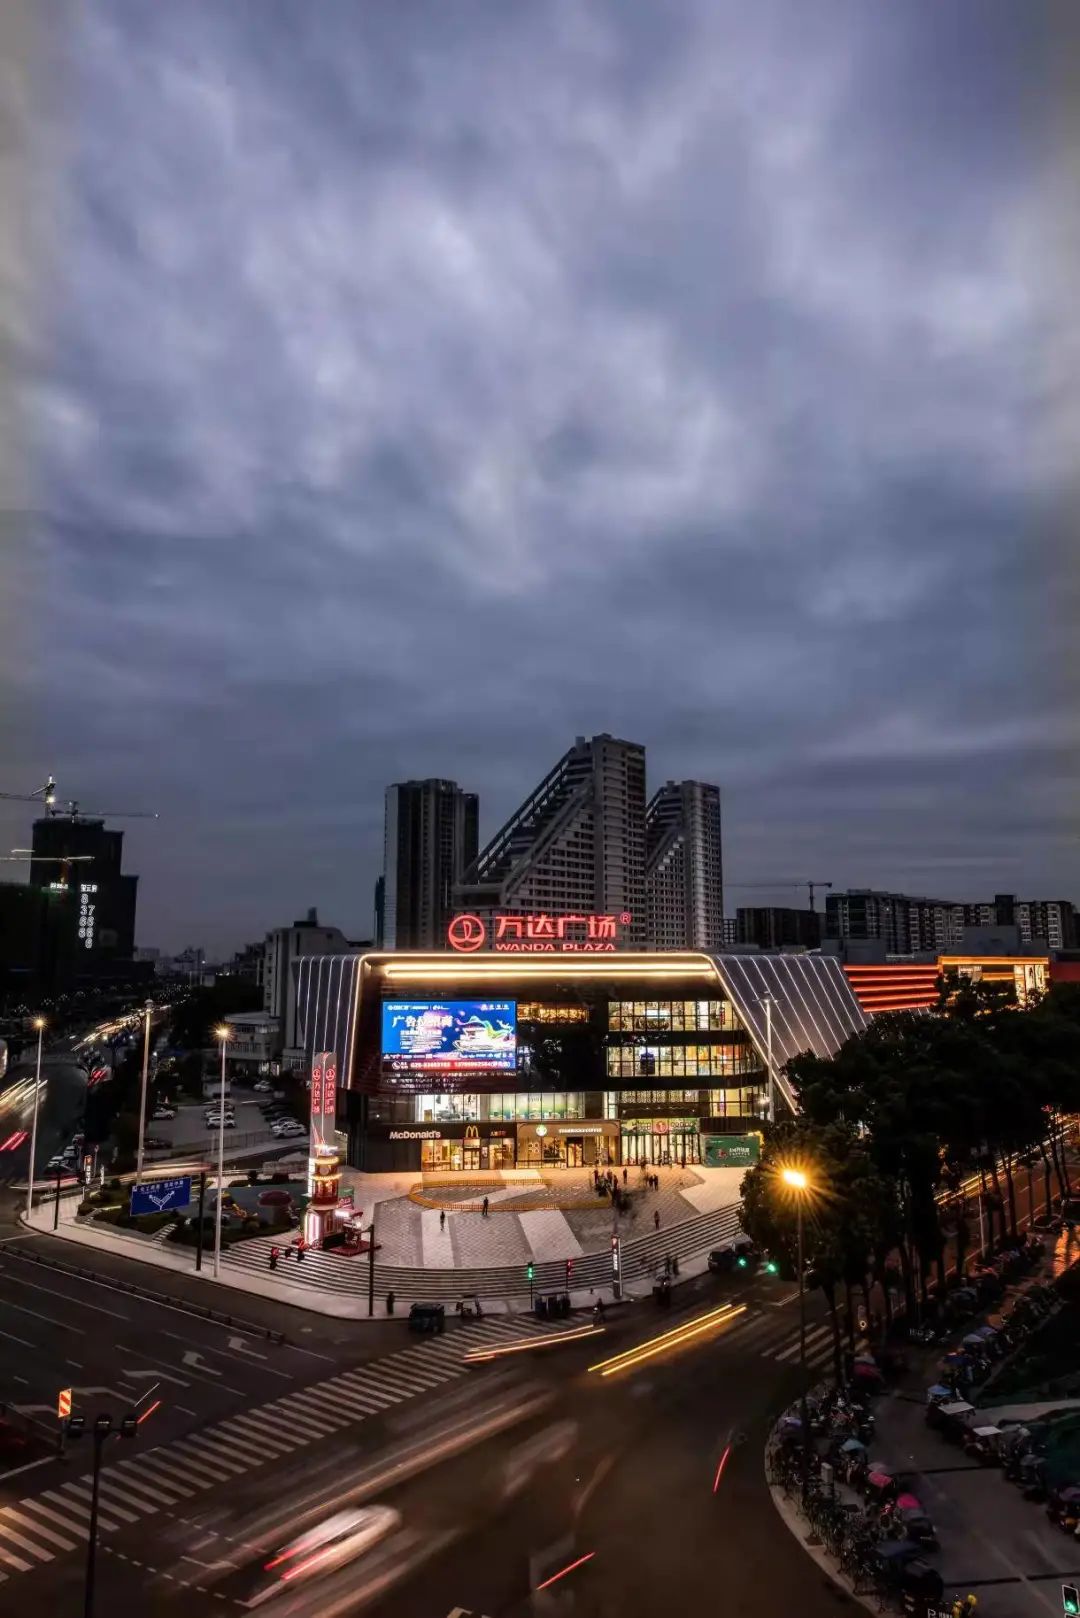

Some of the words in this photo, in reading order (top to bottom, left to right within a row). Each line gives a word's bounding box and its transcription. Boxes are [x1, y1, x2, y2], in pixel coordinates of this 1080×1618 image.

[496, 914, 616, 938] 万达广场
[496, 943, 554, 951] WANDA
[562, 943, 616, 951] PLAZA
[389, 1130, 441, 1139] McDonald's
